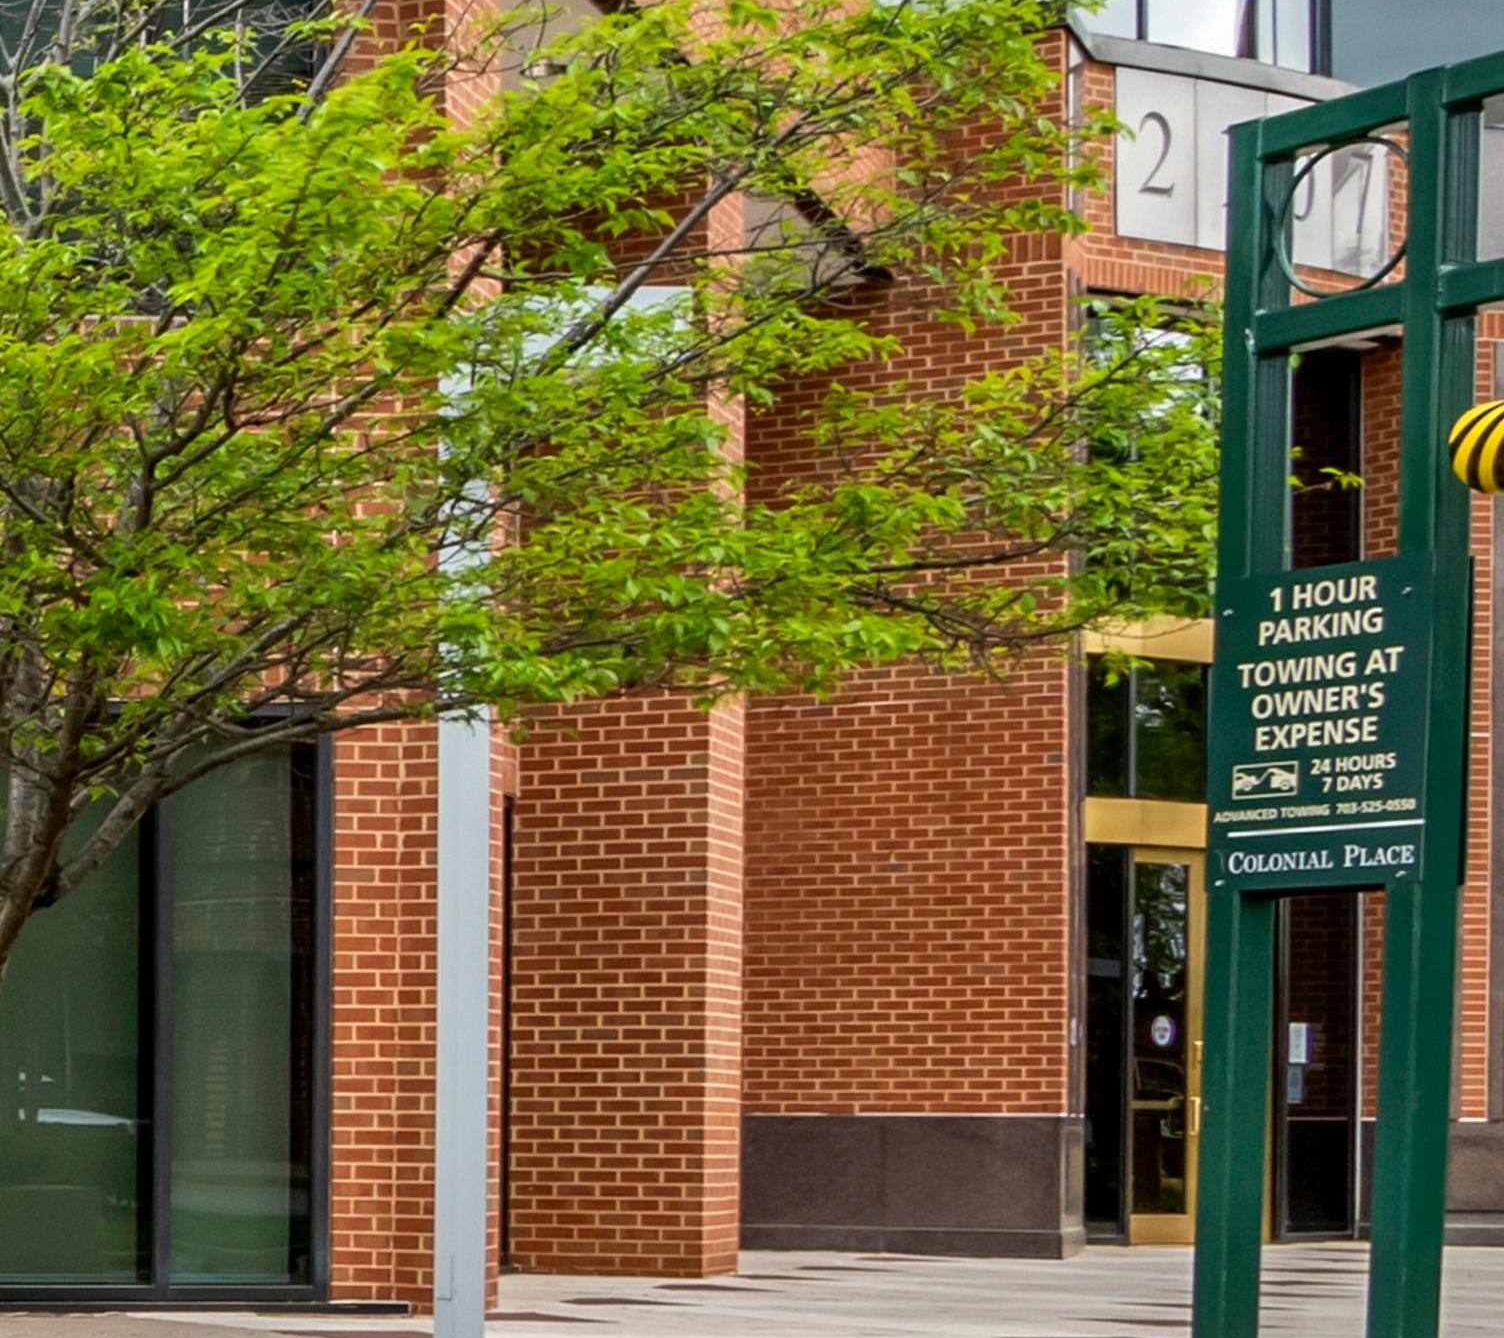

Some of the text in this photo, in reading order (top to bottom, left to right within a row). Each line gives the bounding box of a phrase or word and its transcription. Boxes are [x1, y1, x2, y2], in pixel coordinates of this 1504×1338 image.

[1269, 575, 1378, 612] 1 HOUR
[1258, 607, 1383, 646] PARKING
[1237, 646, 1405, 688] TOWING AT
[1251, 682, 1385, 719] OWNER'S
[1255, 716, 1379, 751] EXPENSE
[1310, 753, 1397, 775] 24 HOURS
[1322, 773, 1384, 793] 7 DAYS
[1213, 808, 1278, 823] ADVANCED
[1281, 804, 1331, 818] TOWING
